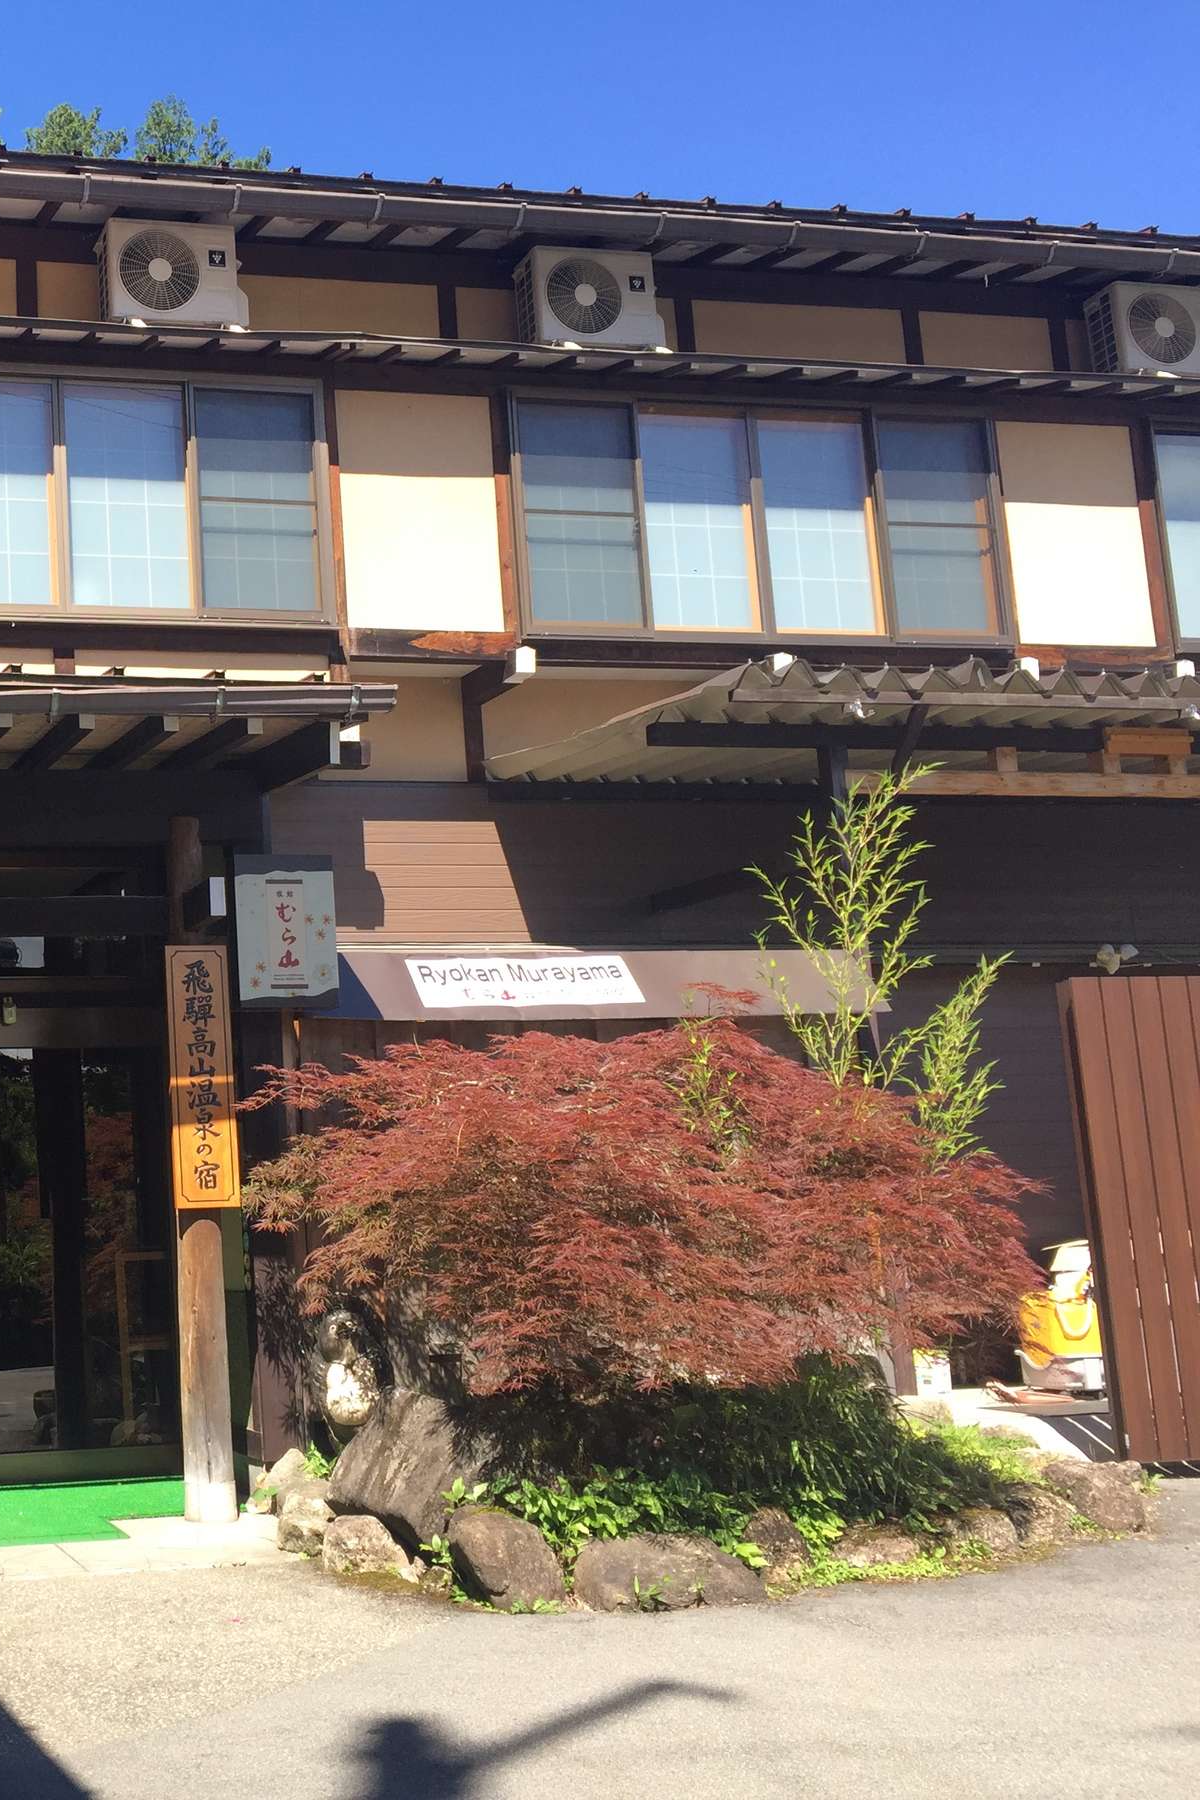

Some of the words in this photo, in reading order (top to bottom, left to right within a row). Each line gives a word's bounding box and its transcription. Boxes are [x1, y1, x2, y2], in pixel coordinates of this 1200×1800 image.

[275, 901, 300, 969] むら山
[417, 963, 503, 985] Ryokan
[506, 962, 623, 983] Murayama
